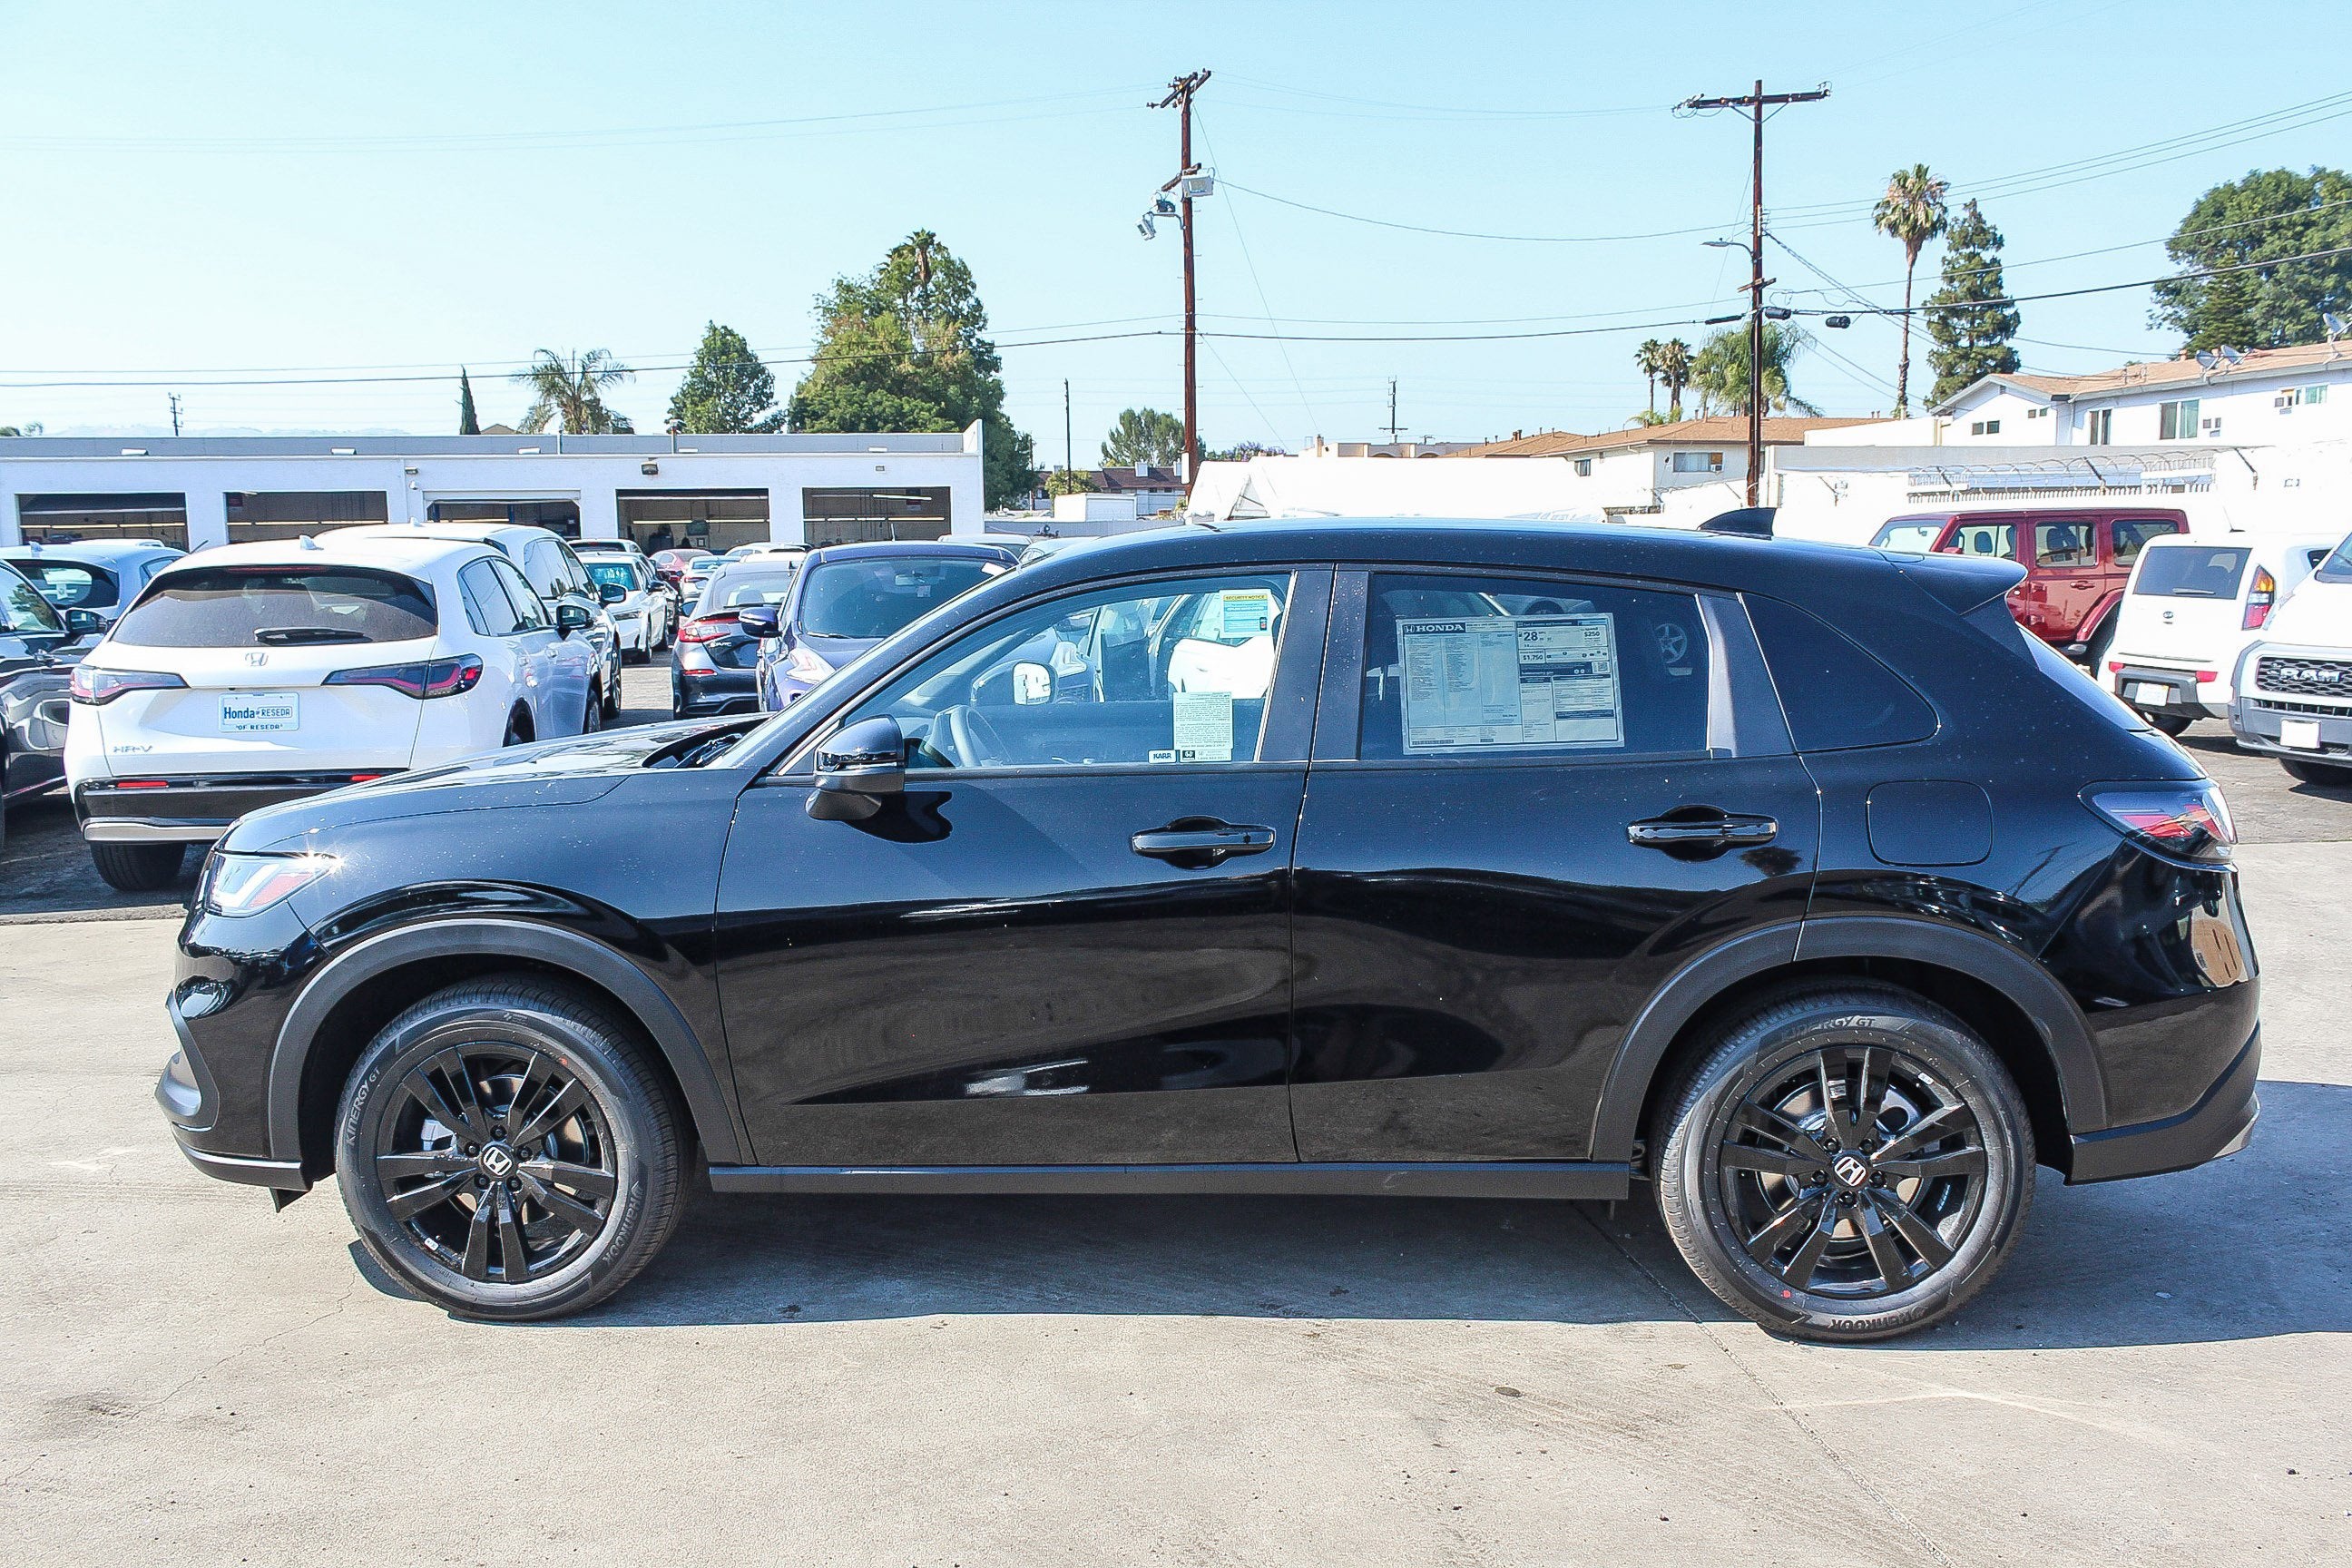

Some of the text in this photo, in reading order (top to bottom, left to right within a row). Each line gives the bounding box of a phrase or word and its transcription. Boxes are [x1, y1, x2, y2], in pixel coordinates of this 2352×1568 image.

[1416, 624, 1465, 632] HONDA
[1523, 631, 1538, 642] 28
[2279, 666, 2340, 684] RAM
[223, 707, 256, 720] Honda
[260, 708, 291, 718] RESEDA
[1152, 751, 1172, 760] KARR
